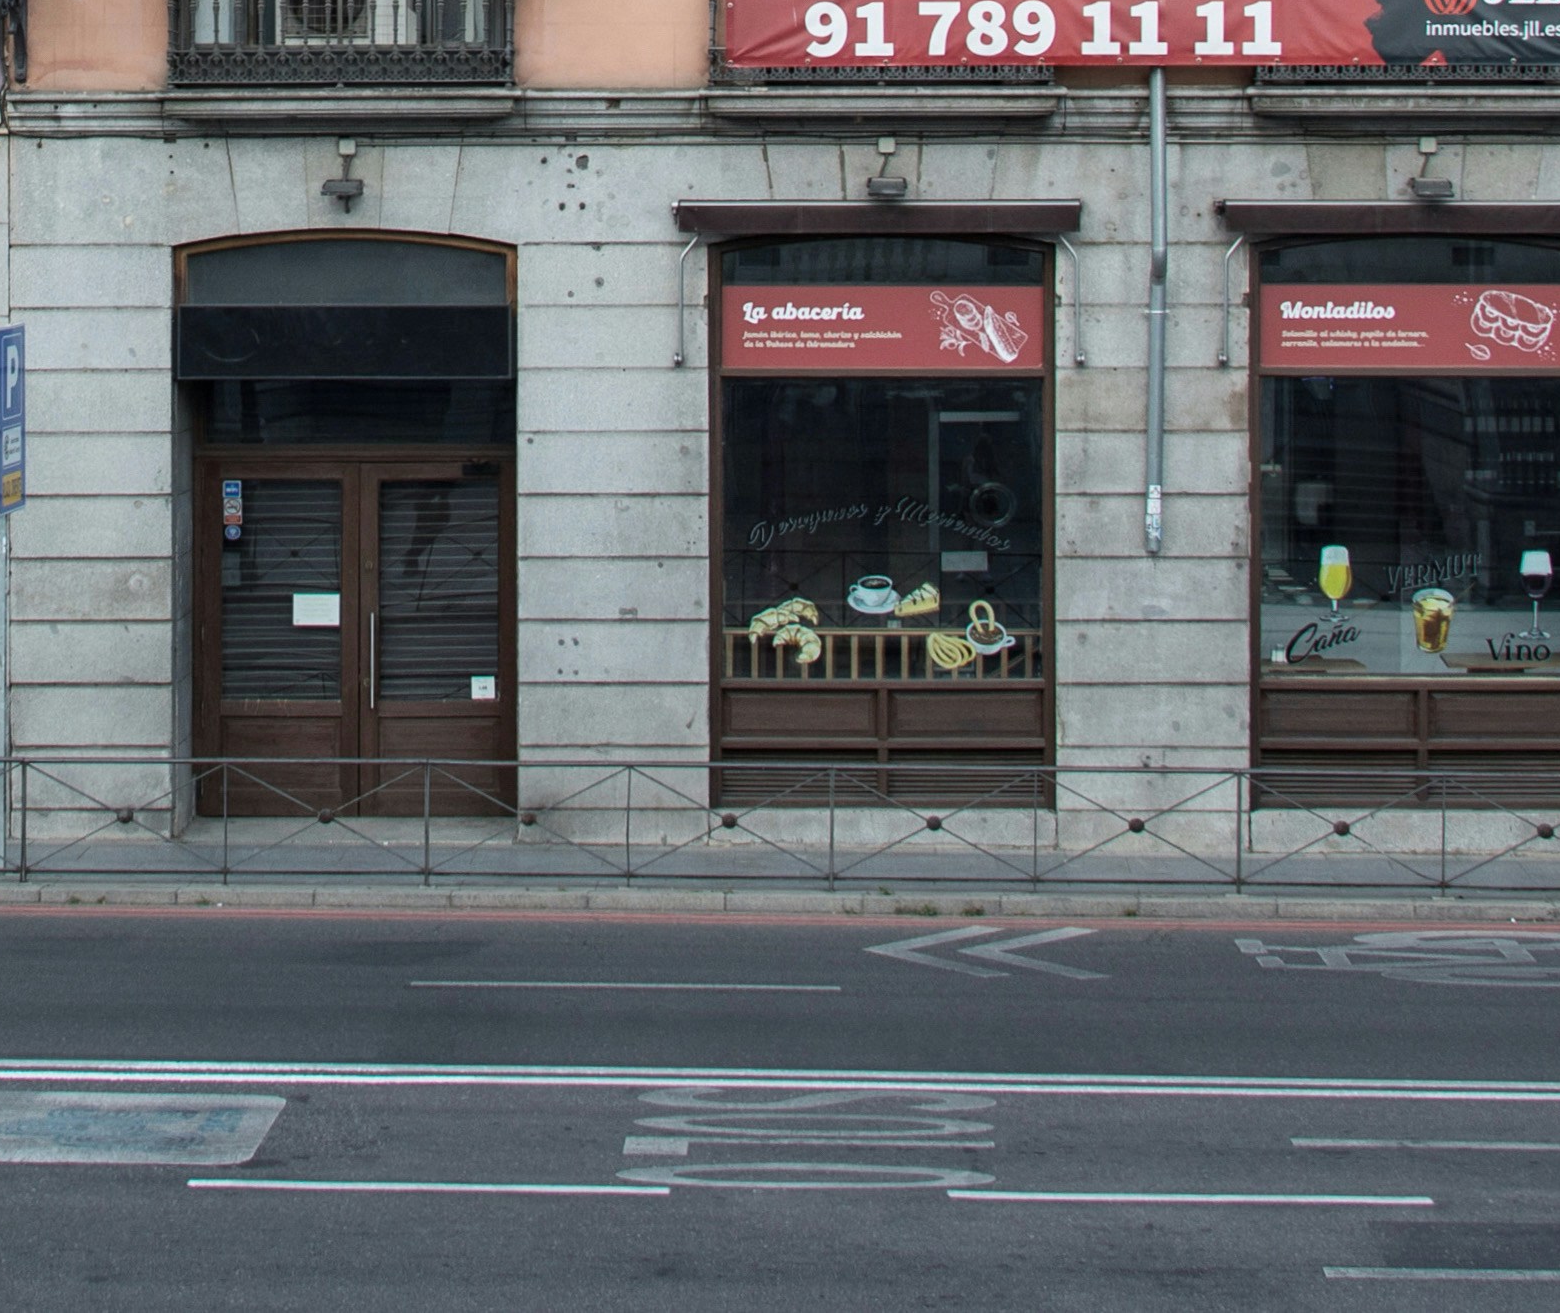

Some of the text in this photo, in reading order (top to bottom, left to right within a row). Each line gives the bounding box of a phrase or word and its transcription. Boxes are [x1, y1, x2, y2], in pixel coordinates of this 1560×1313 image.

[805, 0, 1282, 58] 91 789 11 11
[742, 302, 865, 323] La abacería
[1280, 301, 1396, 319] Montaditos
[6, 345, 19, 409] P
[1285, 622, 1362, 664] Caña
[1485, 632, 1551, 661] Vino
